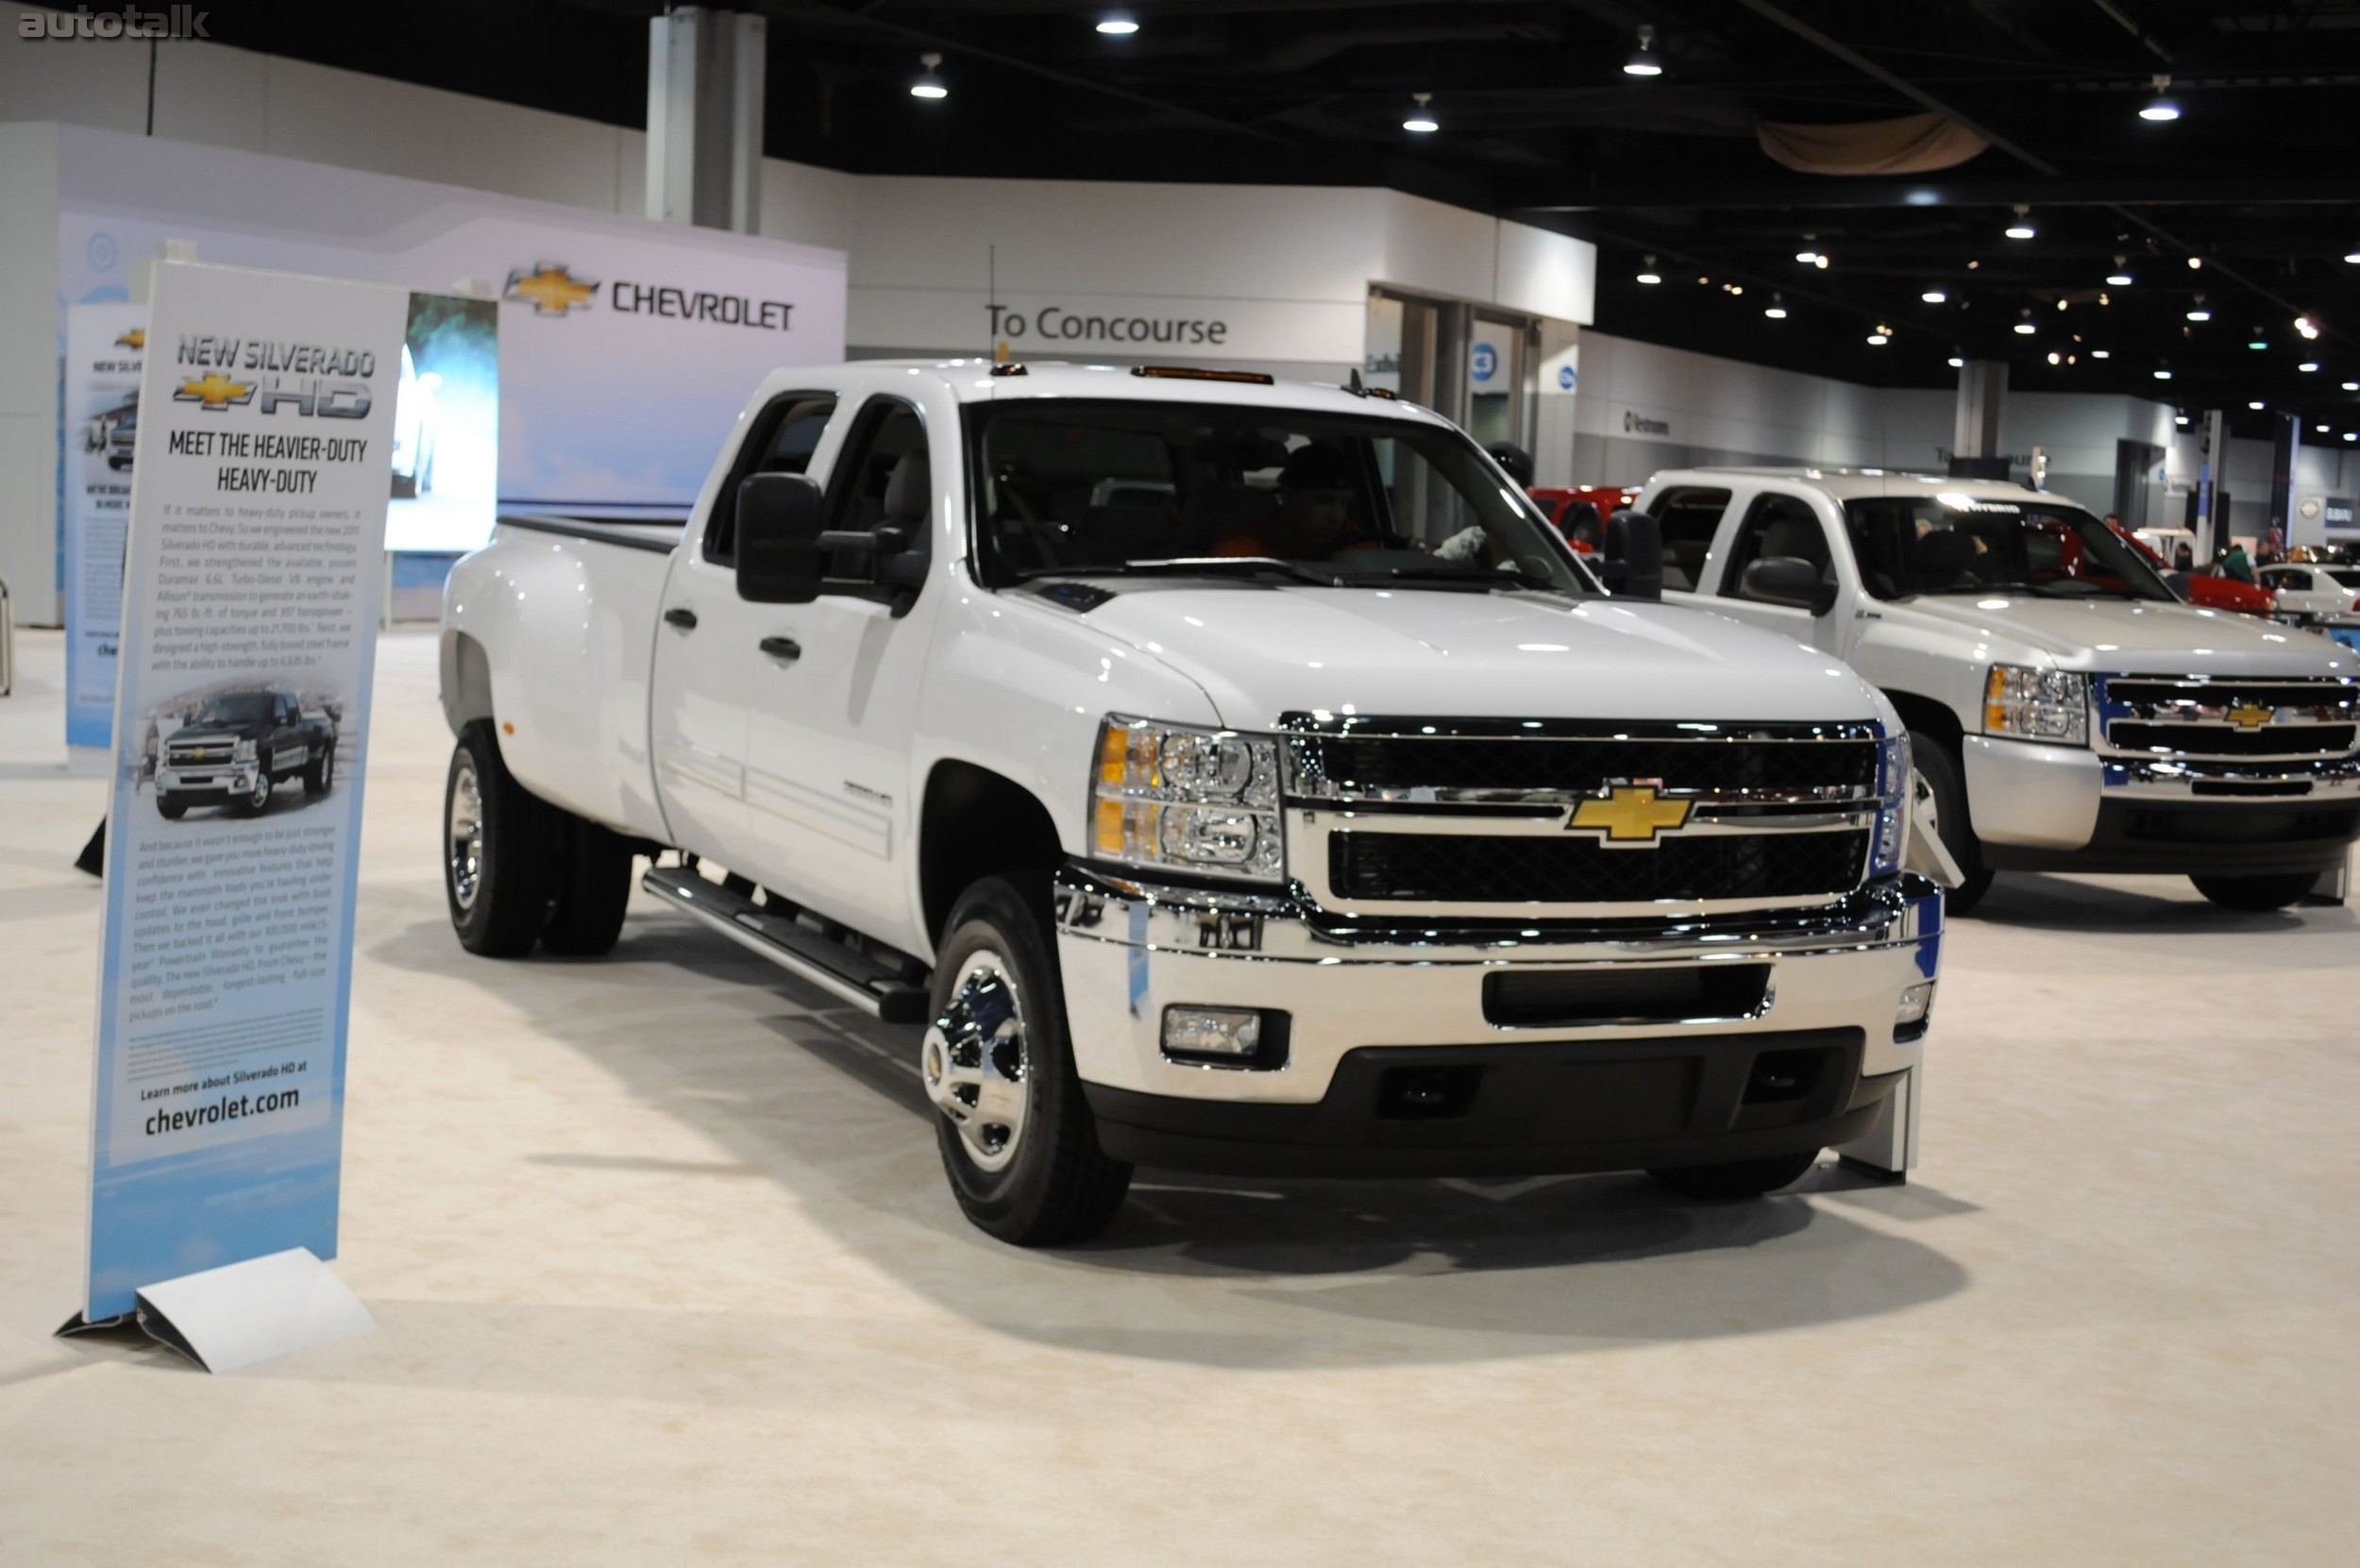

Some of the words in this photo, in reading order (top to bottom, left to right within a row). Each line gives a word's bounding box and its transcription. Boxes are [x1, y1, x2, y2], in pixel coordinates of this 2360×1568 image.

[614, 281, 794, 331] CHEVROLET
[985, 305, 1026, 338] To
[1037, 307, 1227, 345] Concourse
[177, 334, 240, 368] NEW
[244, 341, 376, 379] SILVERADO
[260, 377, 373, 421] HD
[169, 430, 215, 456] MEET
[220, 432, 250, 458] THE
[254, 434, 367, 463] HEAVIER-DUTY
[217, 466, 317, 494] HEAVY-DUTY
[141, 1087, 170, 1102] Learn
[173, 1082, 199, 1095] more
[201, 1076, 230, 1090] about
[233, 1066, 278, 1085] Silverado
[281, 1062, 295, 1075] HD
[297, 1061, 308, 1073] at
[145, 1088, 299, 1136] chevrolet.com
